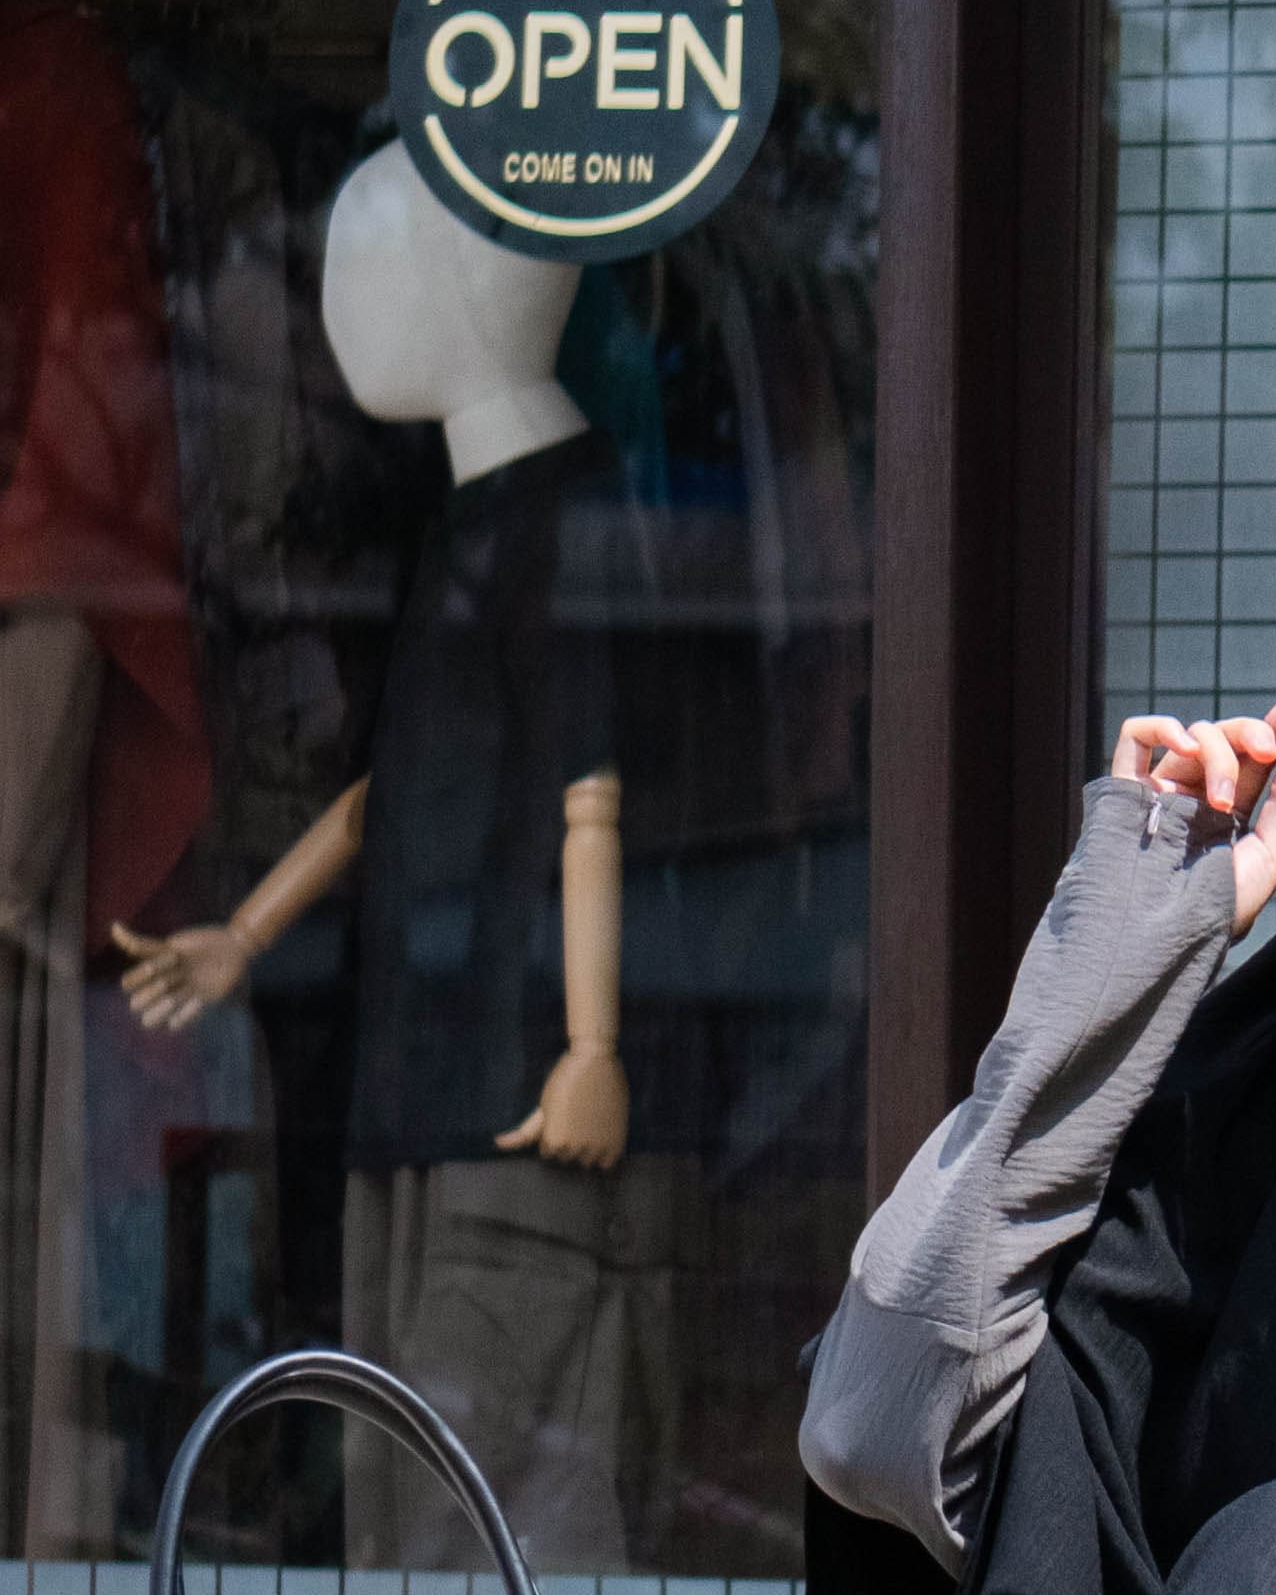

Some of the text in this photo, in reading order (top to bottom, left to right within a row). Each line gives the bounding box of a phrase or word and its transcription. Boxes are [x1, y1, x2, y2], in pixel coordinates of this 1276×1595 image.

[425, 10, 743, 111] OPEN
[504, 152, 653, 183] COME ON IN
